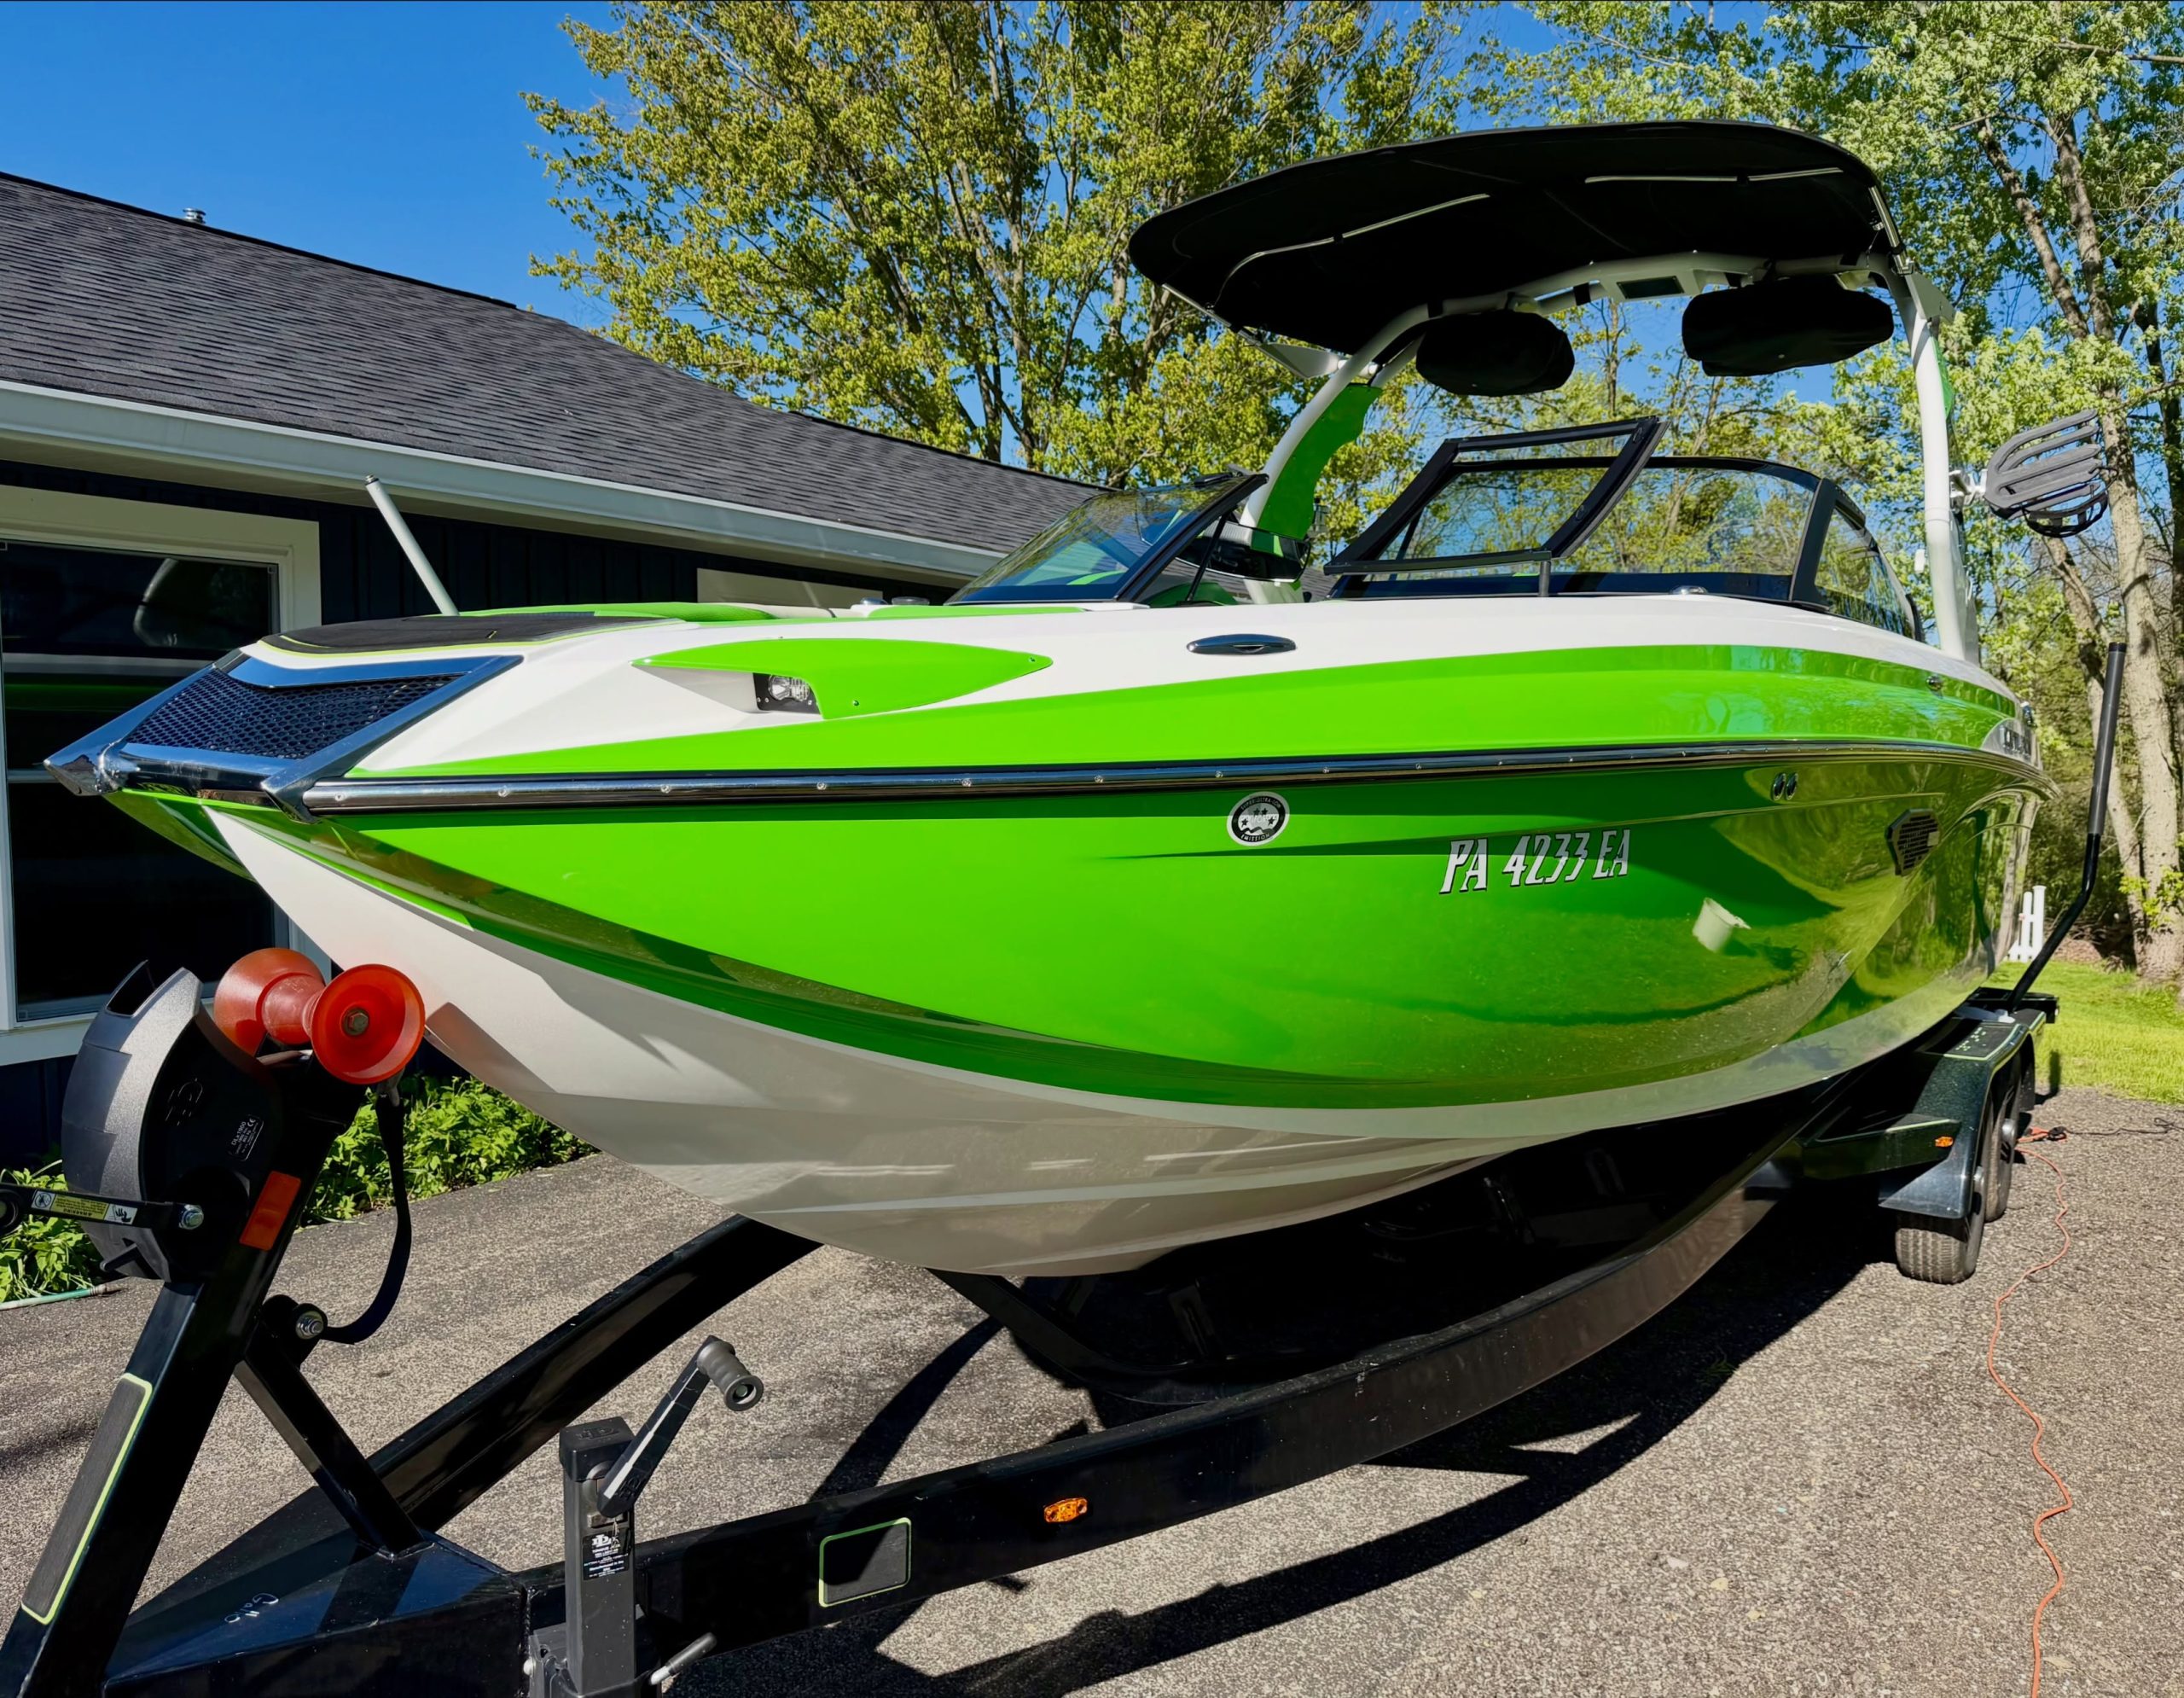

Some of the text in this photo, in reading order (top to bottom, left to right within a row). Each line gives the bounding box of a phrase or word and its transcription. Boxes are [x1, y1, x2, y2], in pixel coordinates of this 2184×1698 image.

[1439, 829, 1631, 894] PA 4233 EA
